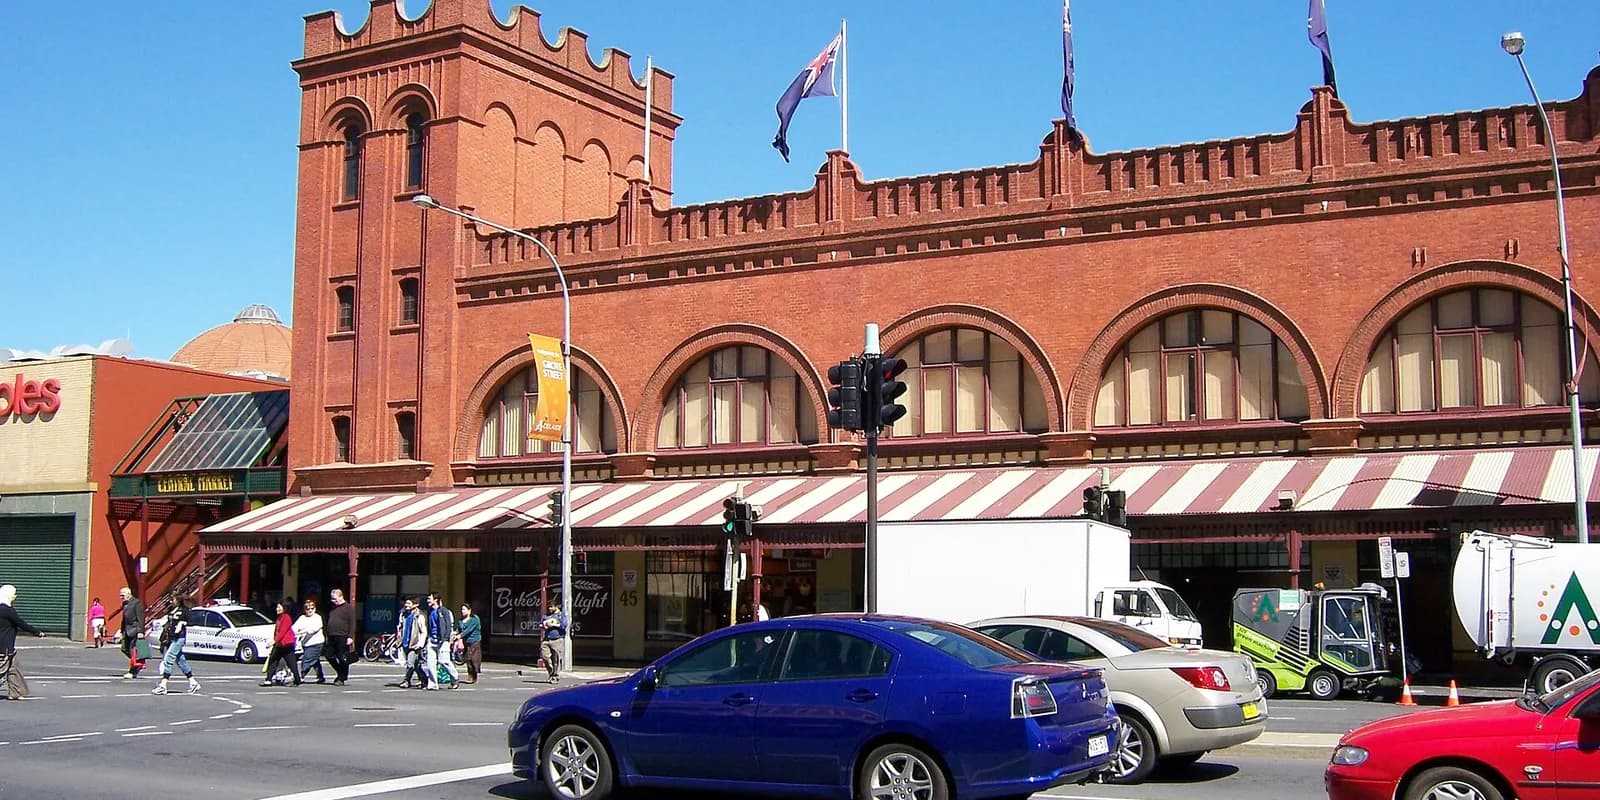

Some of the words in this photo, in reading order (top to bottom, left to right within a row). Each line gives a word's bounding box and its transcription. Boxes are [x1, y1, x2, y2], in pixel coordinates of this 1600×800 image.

[158, 476, 195, 492] CENTRAL
[198, 475, 233, 491] MARKET
[496, 587, 542, 609] Baker
[552, 588, 608, 615] light
[620, 590, 638, 607] 45
[520, 620, 542, 631] OPE
[194, 641, 223, 649] Police
